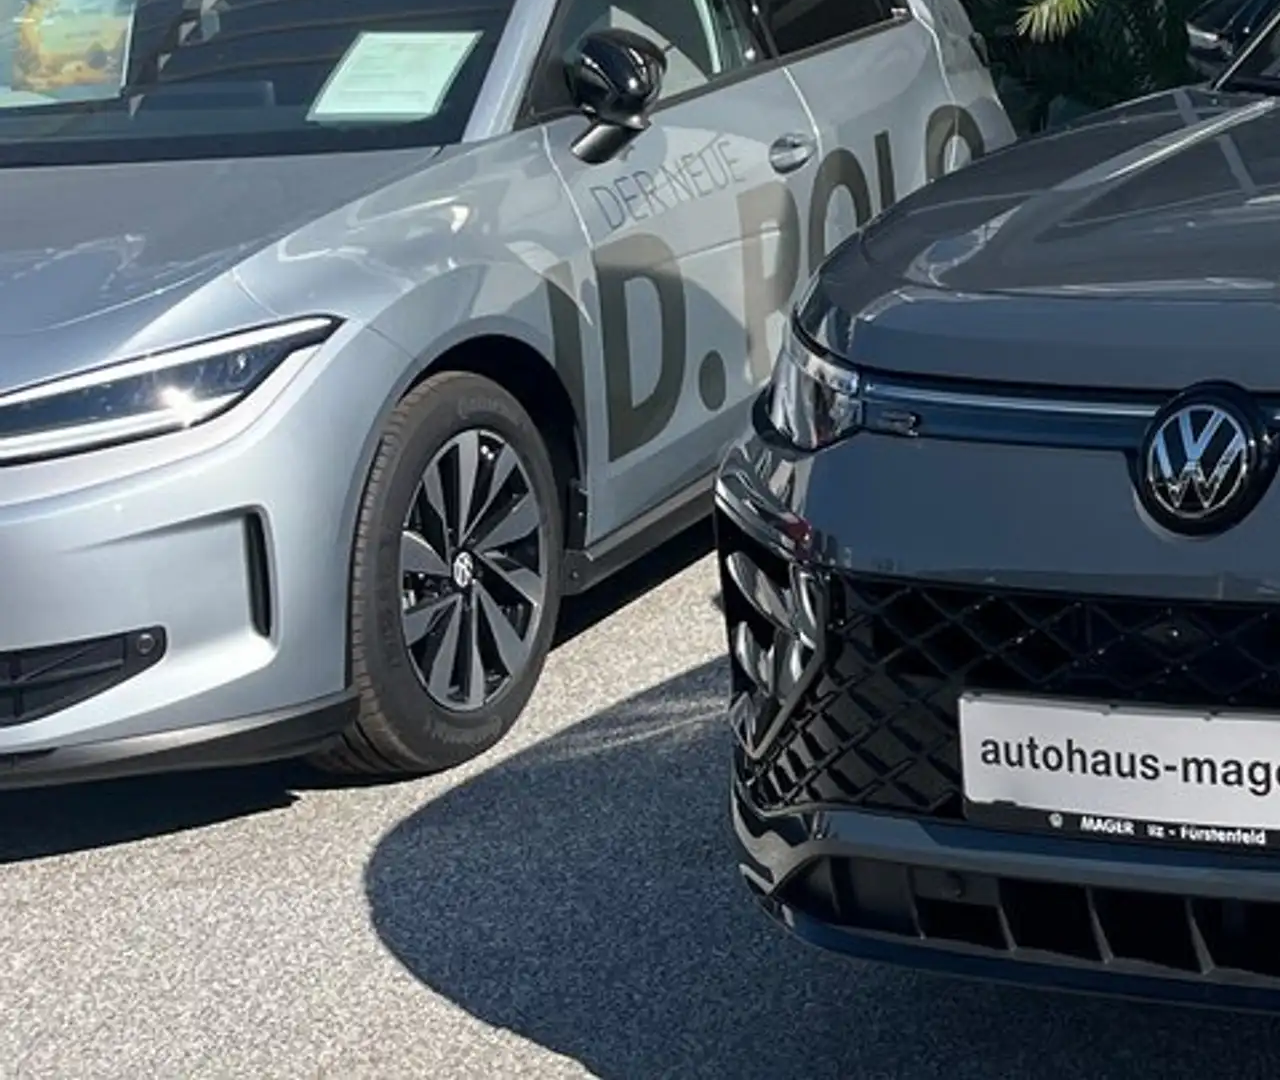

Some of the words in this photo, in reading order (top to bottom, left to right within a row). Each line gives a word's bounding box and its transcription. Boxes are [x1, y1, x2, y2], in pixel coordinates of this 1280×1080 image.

[590, 170, 667, 231] DER
[661, 140, 747, 208] NEUE
[1080, 815, 1135, 836] MAGER
[1180, 826, 1266, 845] Fürstenfeld
